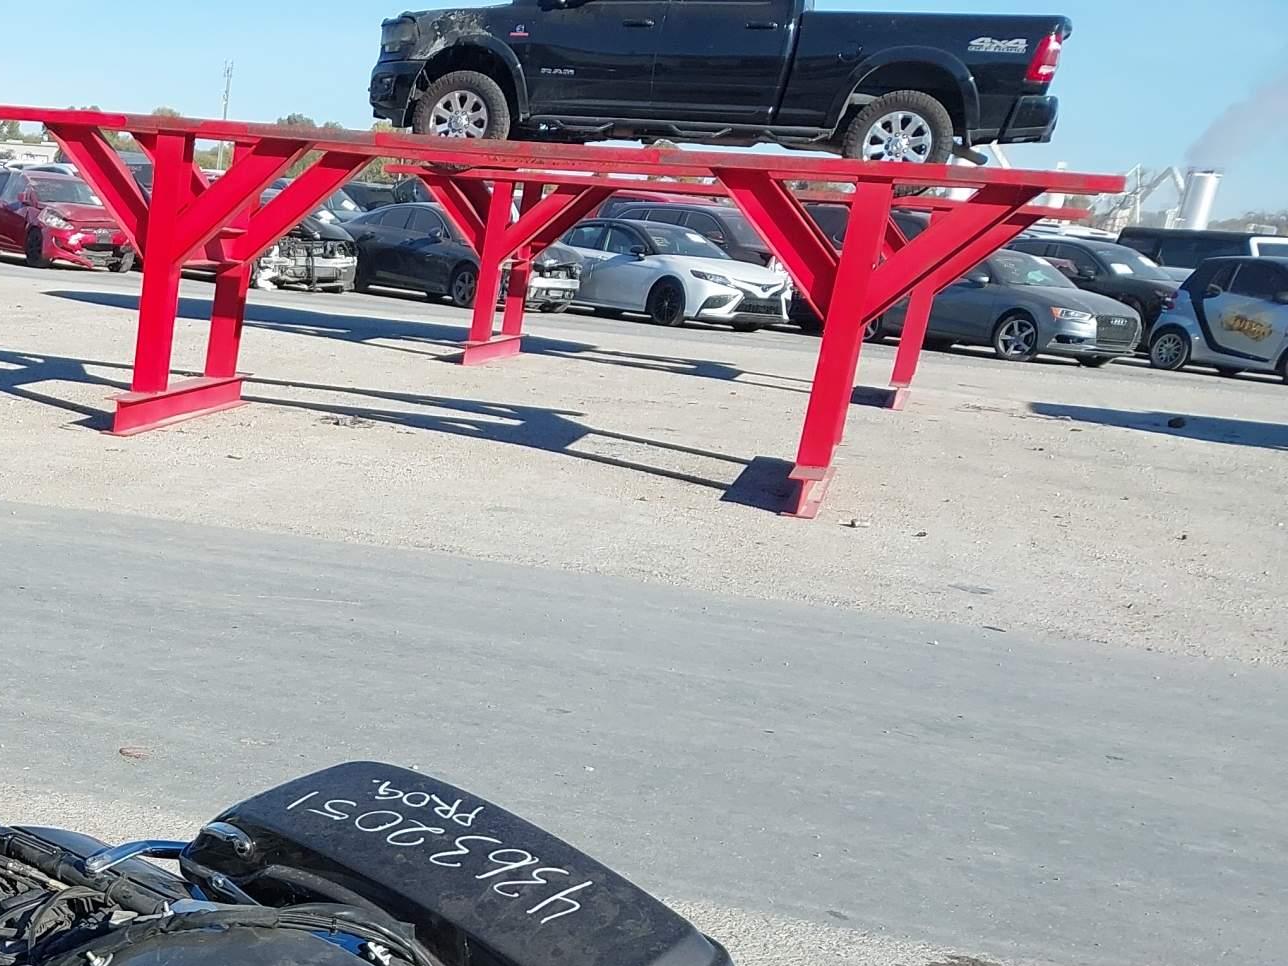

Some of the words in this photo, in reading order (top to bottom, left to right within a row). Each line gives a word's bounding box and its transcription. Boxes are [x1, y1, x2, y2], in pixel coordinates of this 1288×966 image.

[969, 36, 1029, 48] 4x4
[540, 67, 575, 75] RAM
[286, 791, 593, 924] 43632051
